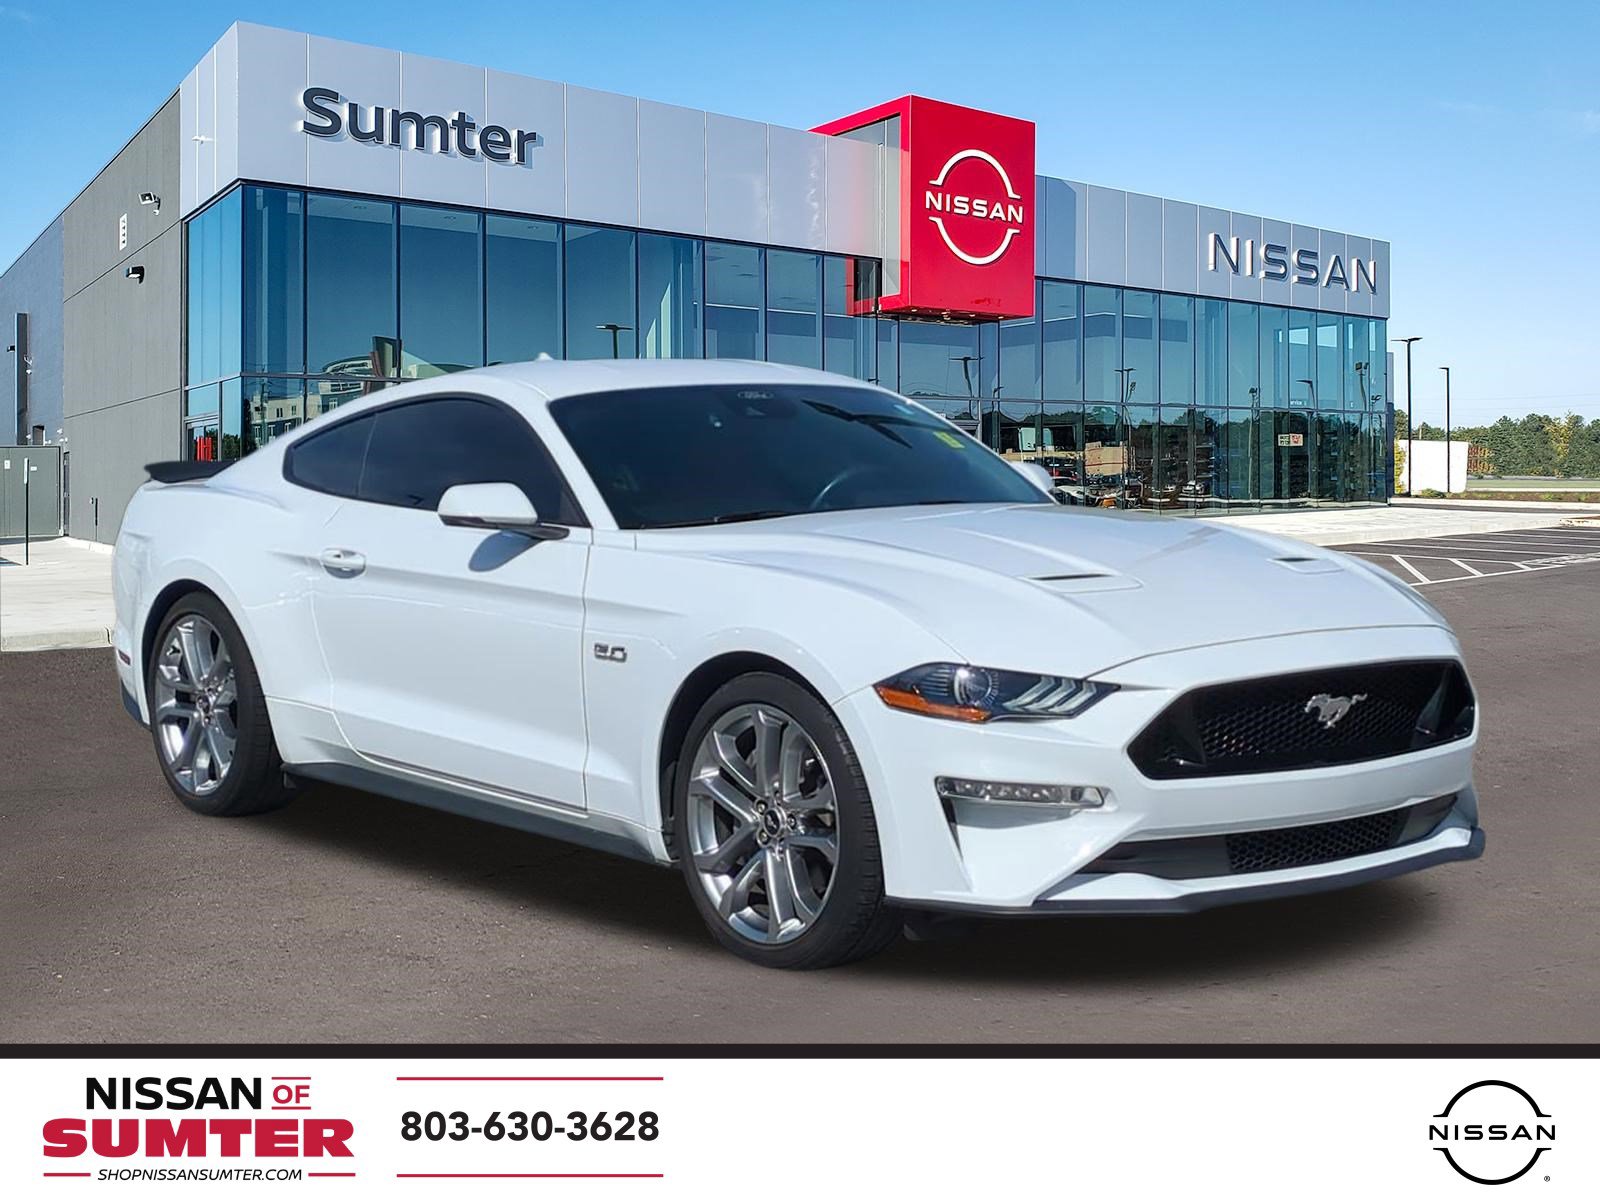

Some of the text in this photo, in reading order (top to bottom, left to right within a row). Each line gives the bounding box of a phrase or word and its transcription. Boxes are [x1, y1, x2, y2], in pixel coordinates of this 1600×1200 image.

[301, 86, 538, 166] Sumter
[925, 190, 1023, 224] NISSAN
[1208, 232, 1377, 294] NISSAN
